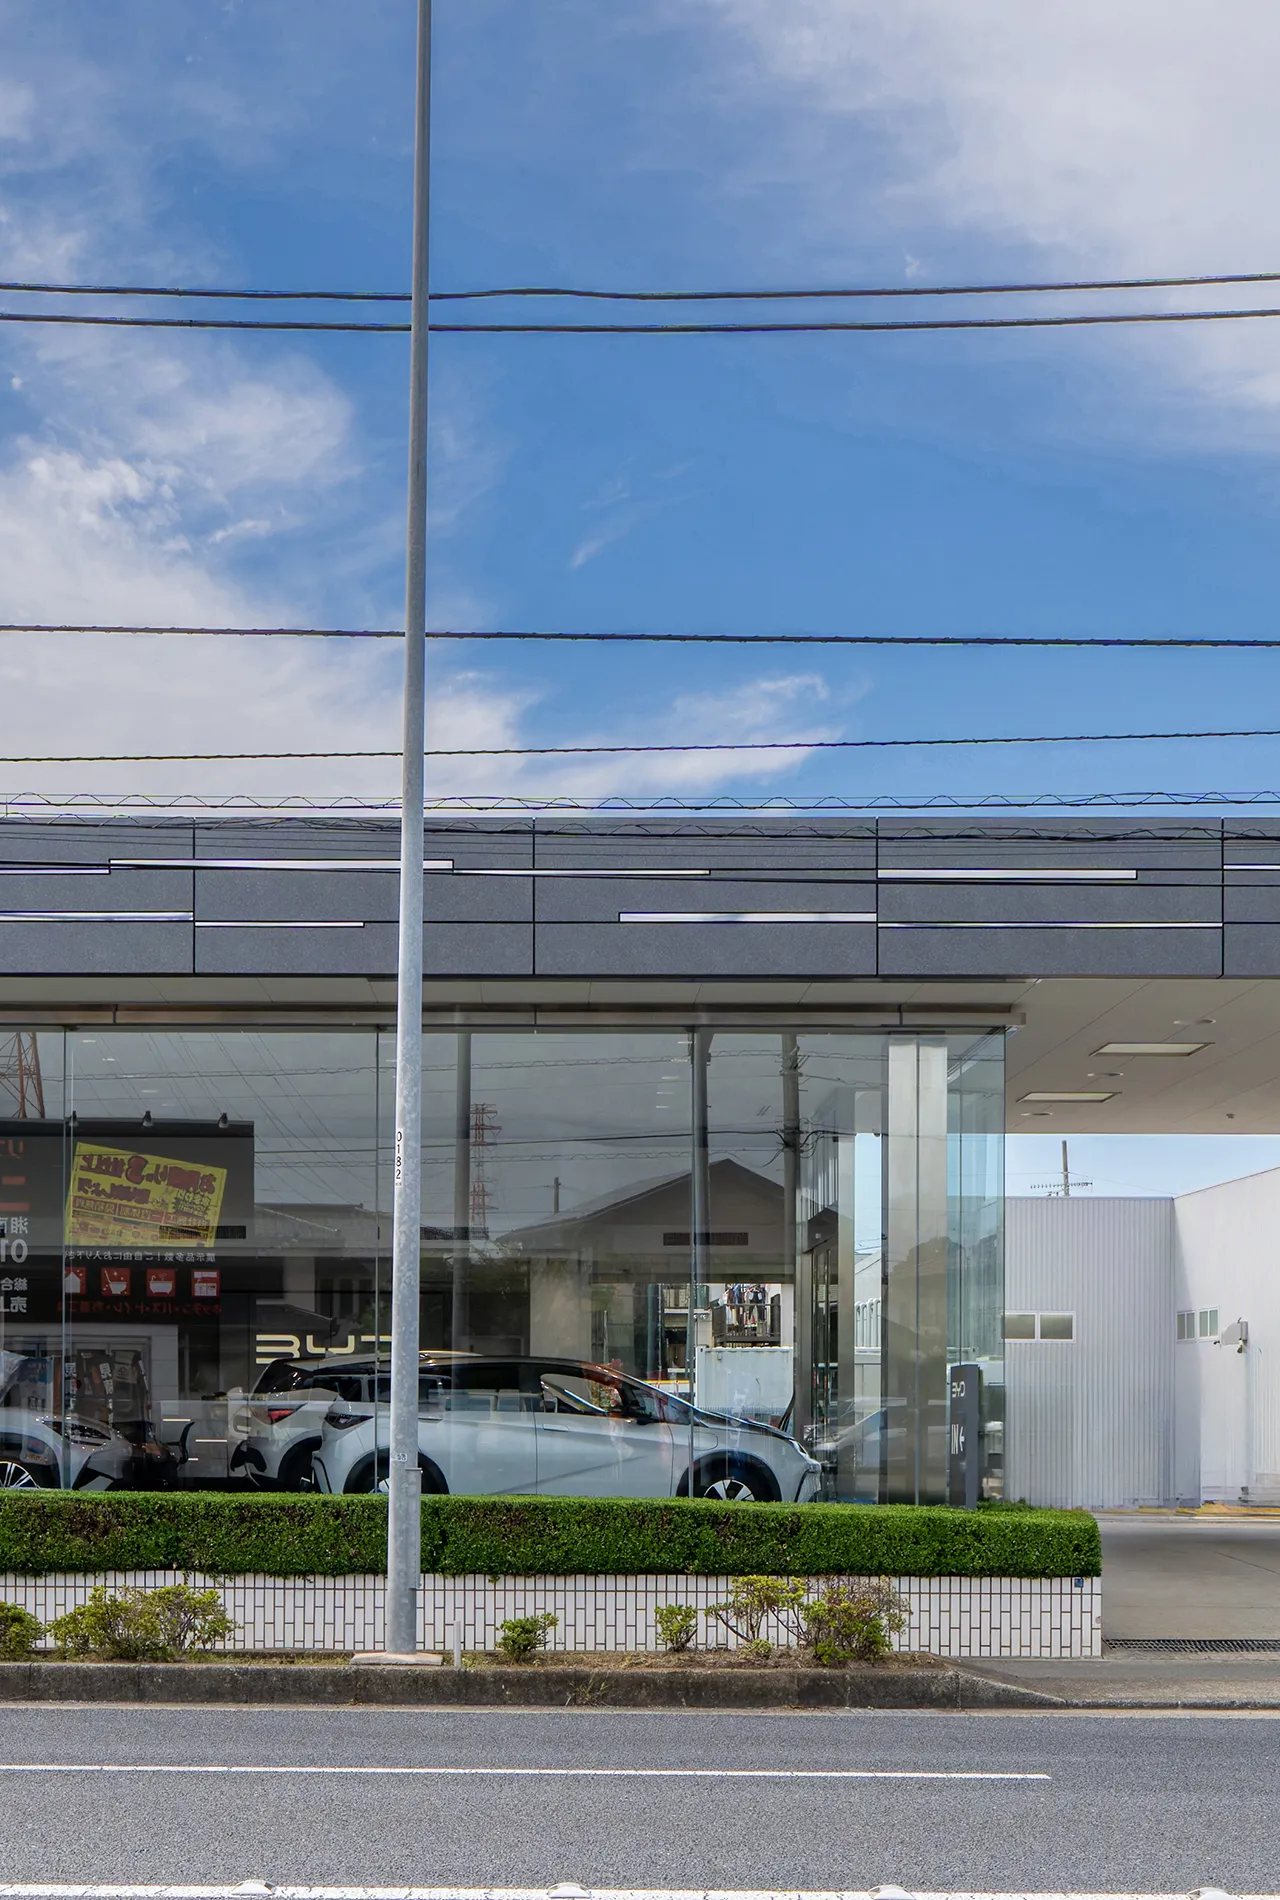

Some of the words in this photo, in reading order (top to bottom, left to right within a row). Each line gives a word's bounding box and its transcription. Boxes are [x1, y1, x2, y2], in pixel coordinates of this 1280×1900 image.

[395, 1131, 403, 1180] 0182
[256, 1334, 392, 1365] BY
[952, 1381, 965, 1397] BYD
[951, 1424, 958, 1454] IN
